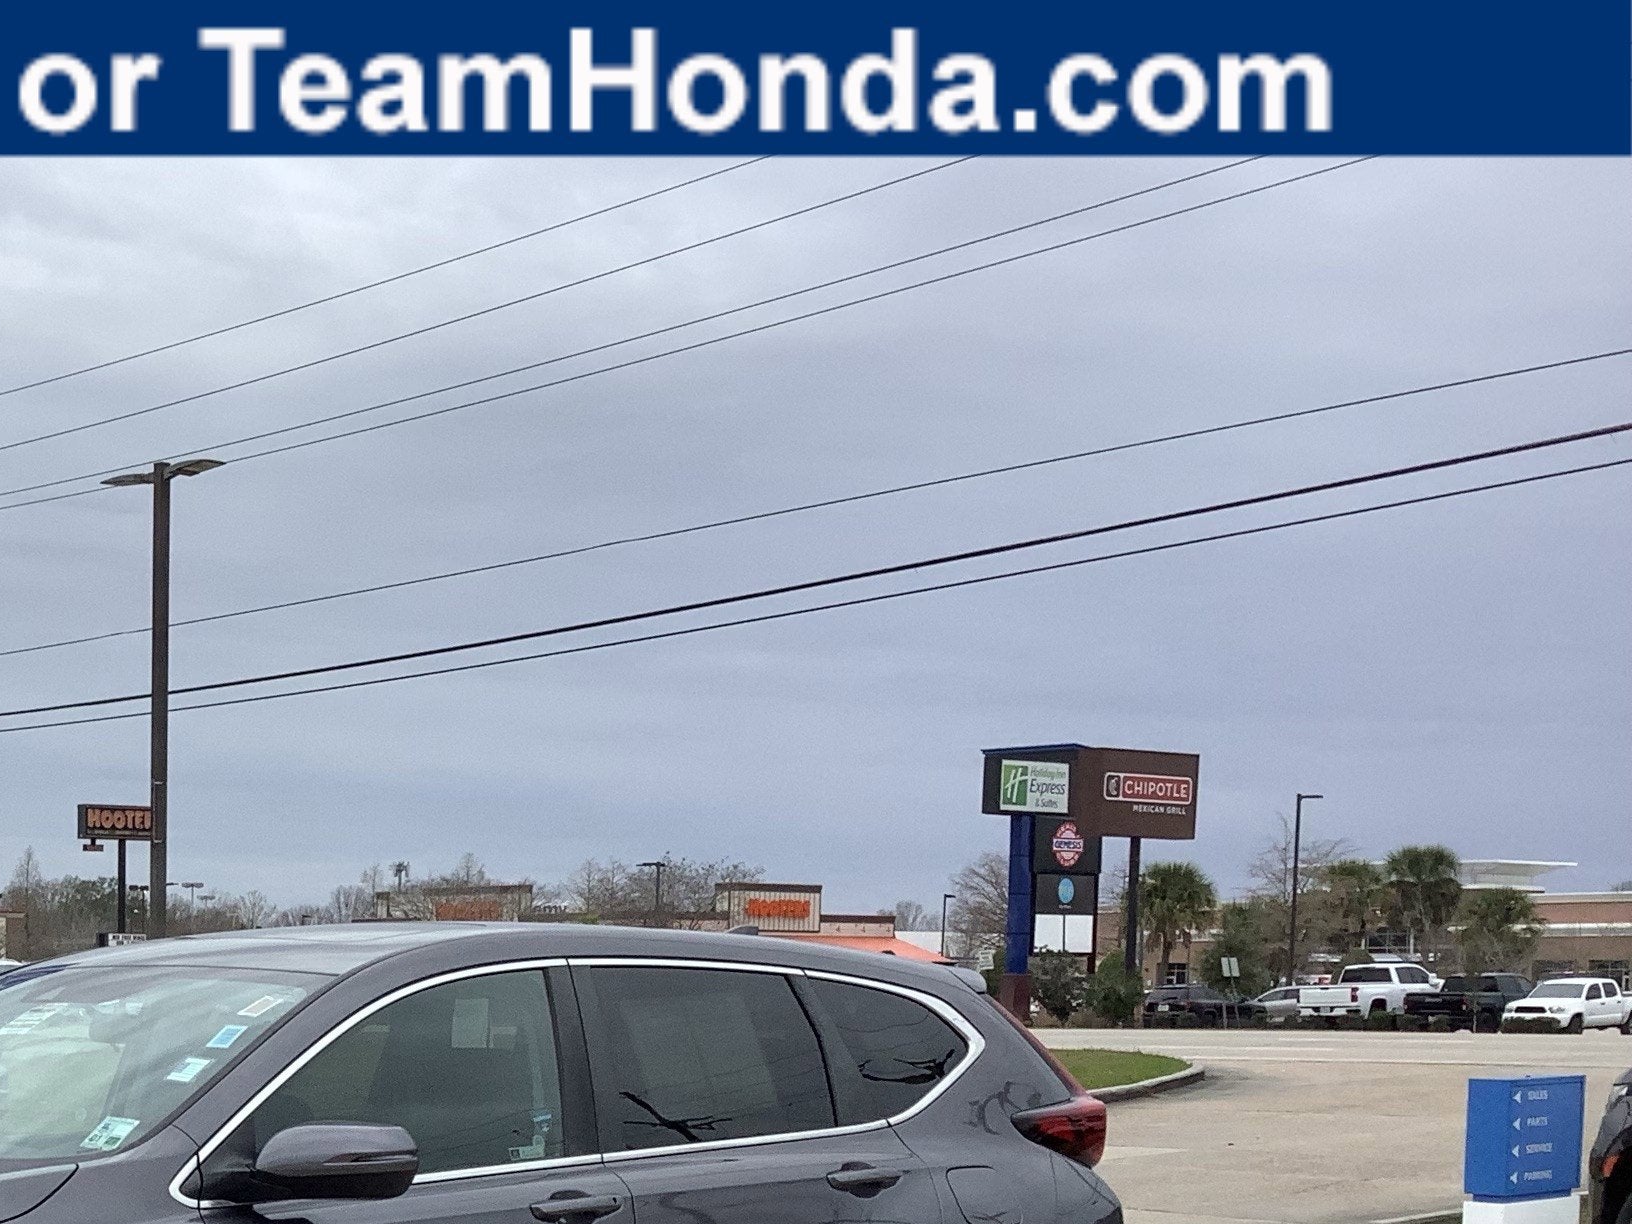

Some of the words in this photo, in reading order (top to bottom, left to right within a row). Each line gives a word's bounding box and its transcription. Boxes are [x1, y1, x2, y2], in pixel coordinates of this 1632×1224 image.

[1030, 779, 1066, 796] Express
[1124, 780, 1188, 798] CHIPOTLE
[1133, 804, 1164, 813] MEXICAN
[1166, 806, 1186, 815] GRILL
[87, 808, 152, 829] HOOTE
[1054, 840, 1082, 849] GENESIS
